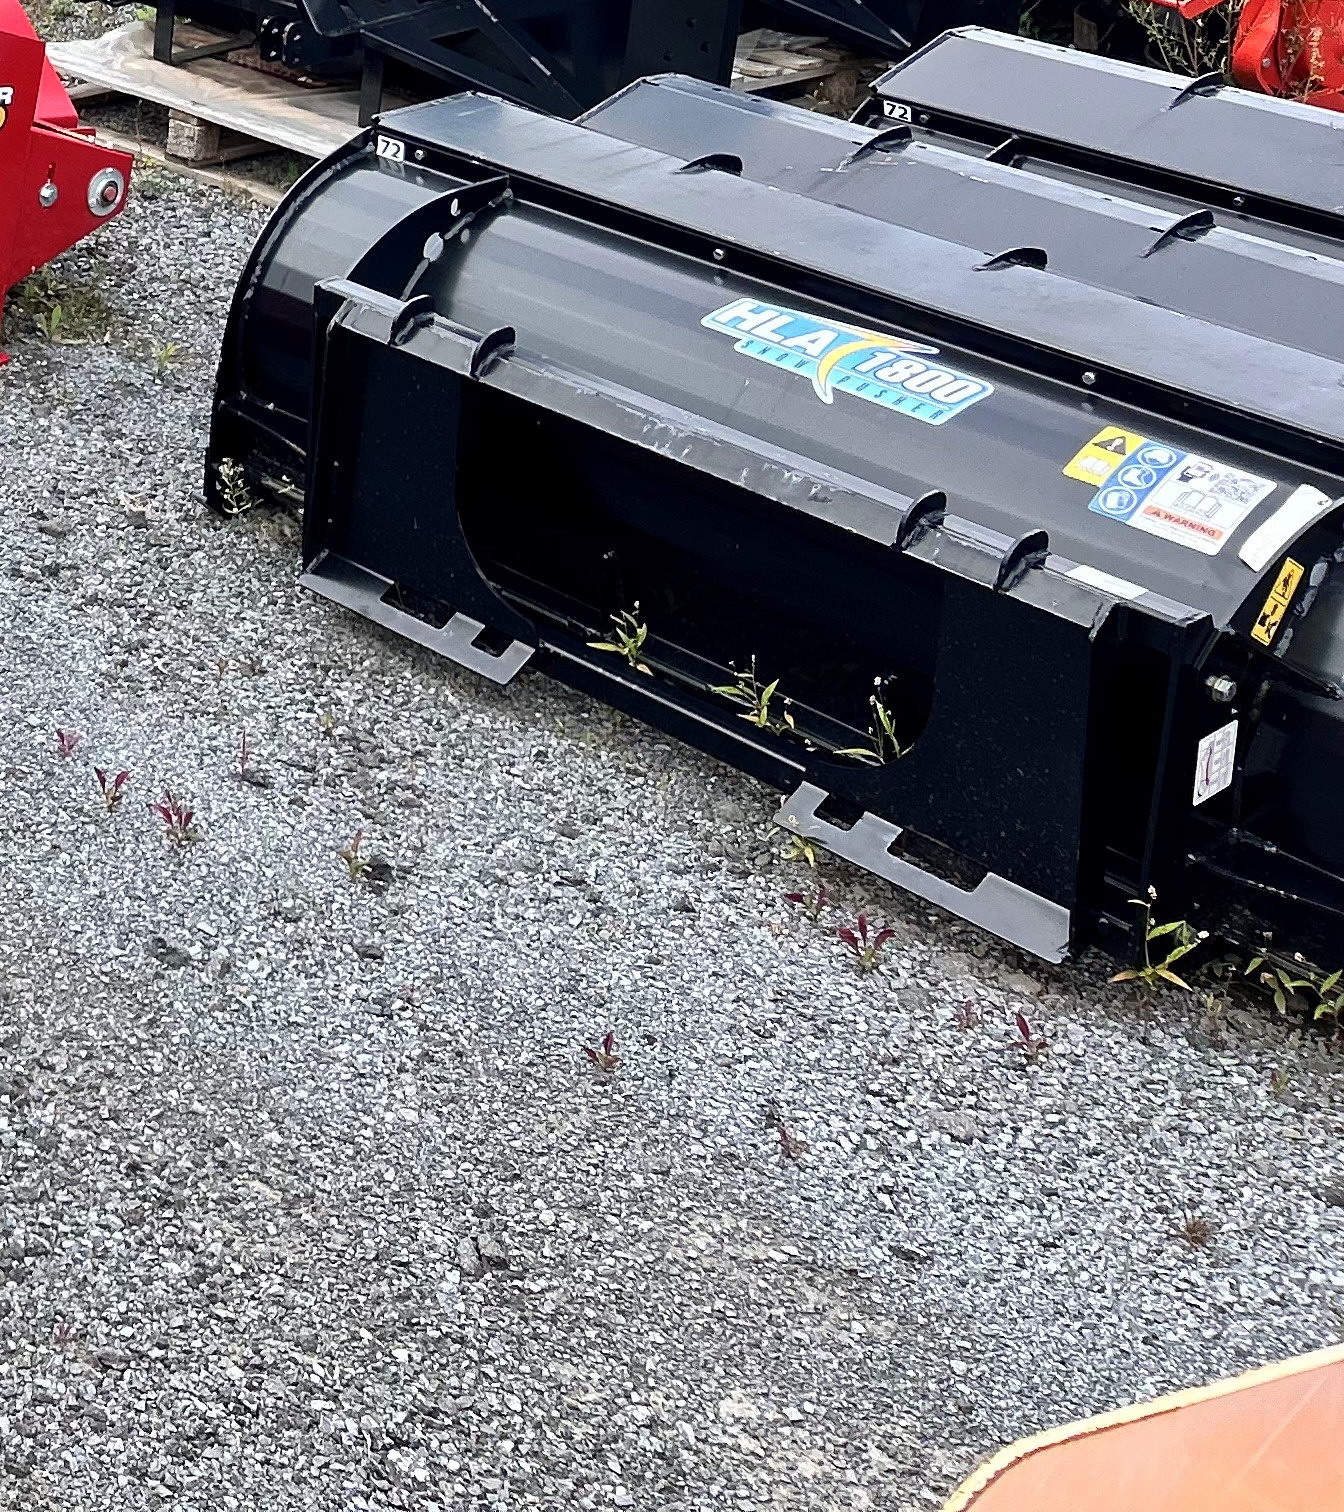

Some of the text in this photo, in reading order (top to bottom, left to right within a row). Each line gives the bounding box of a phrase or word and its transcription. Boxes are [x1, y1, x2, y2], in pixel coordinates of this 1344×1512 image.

[885, 102, 909, 120] 72
[379, 138, 402, 159] 72
[711, 301, 984, 404] HLA 1800
[739, 339, 945, 420] SNOW PUSHER
[1162, 513, 1217, 538] WARNING
